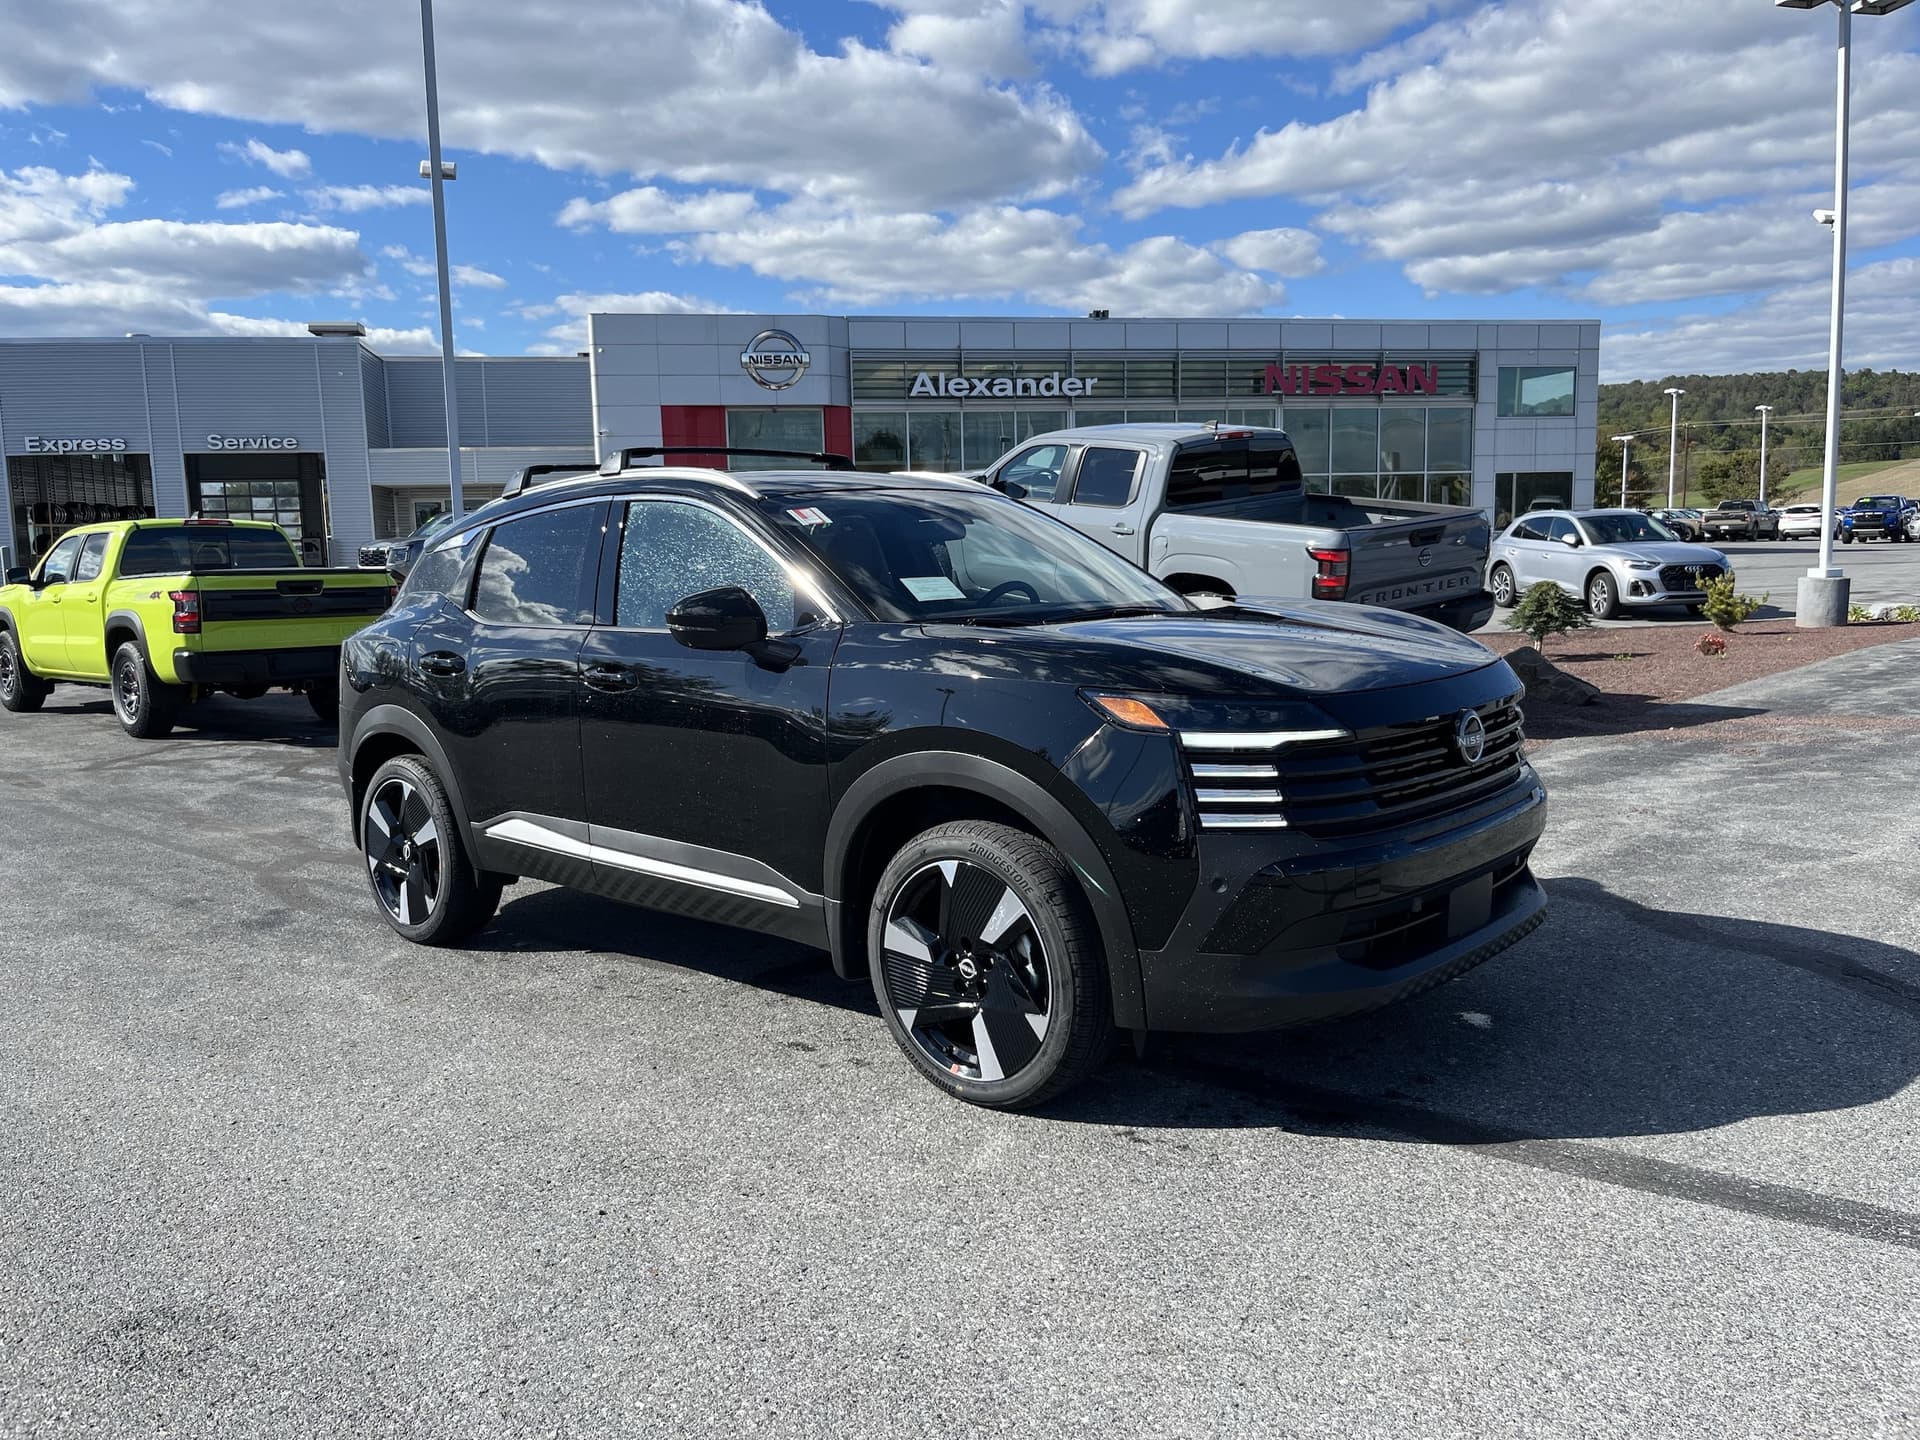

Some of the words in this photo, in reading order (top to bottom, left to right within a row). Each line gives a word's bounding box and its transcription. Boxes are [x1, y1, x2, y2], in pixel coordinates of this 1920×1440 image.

[748, 354, 804, 366] NISSAN
[909, 371, 1099, 398] Alexander
[1263, 363, 1439, 395] NISSAN
[24, 435, 127, 455] Express
[206, 434, 298, 450] Service
[1359, 575, 1471, 605] FRONTIER
[967, 842, 1035, 896] BRIDGESTONE
